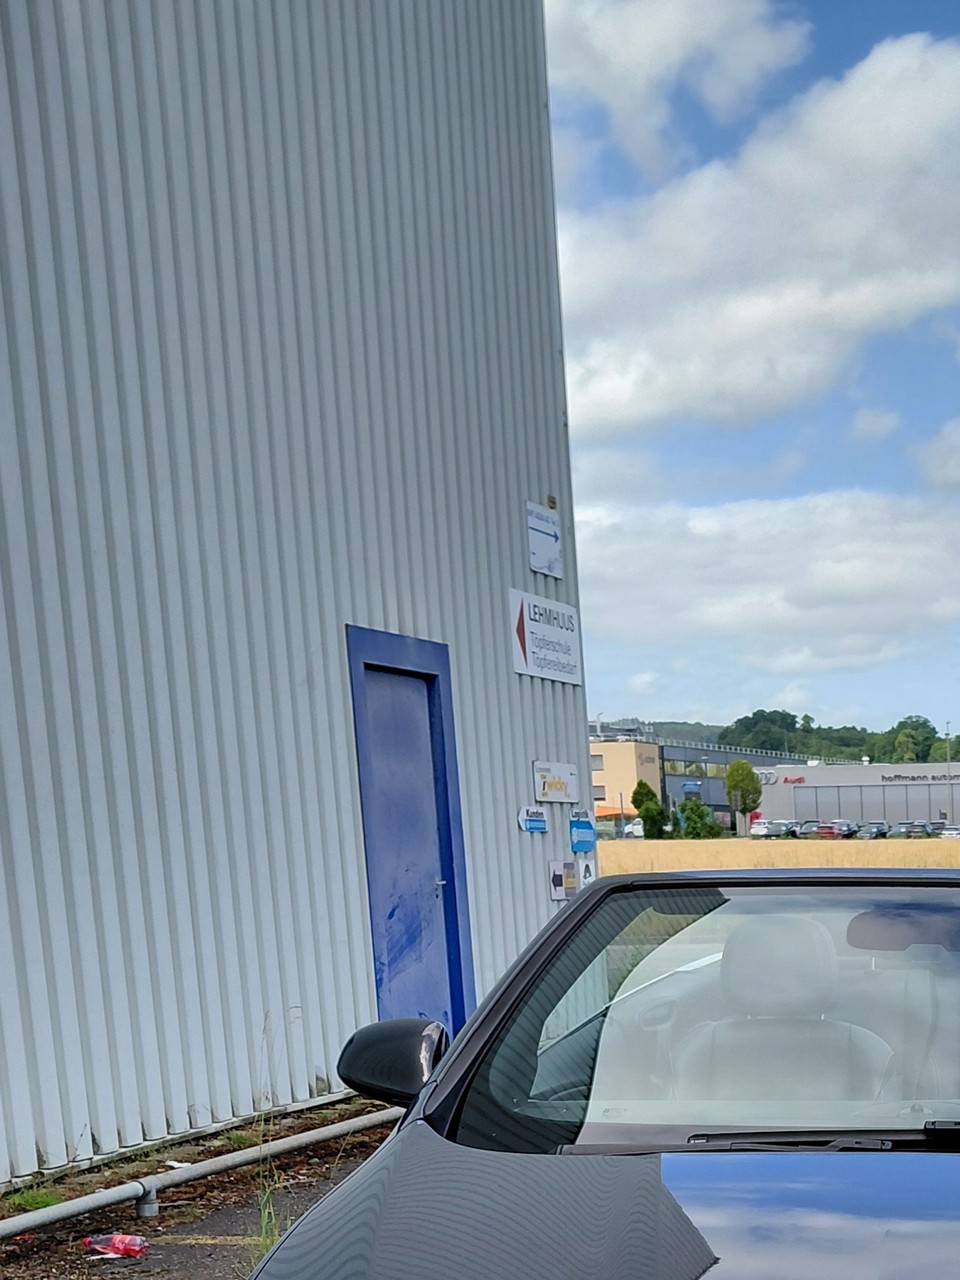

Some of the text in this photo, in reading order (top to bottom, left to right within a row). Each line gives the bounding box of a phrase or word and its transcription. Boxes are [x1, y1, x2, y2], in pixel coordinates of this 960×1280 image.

[528, 603, 575, 632] LEHMHUUS
[783, 776, 805, 784] Audi
[881, 774, 929, 783] hoffmann
